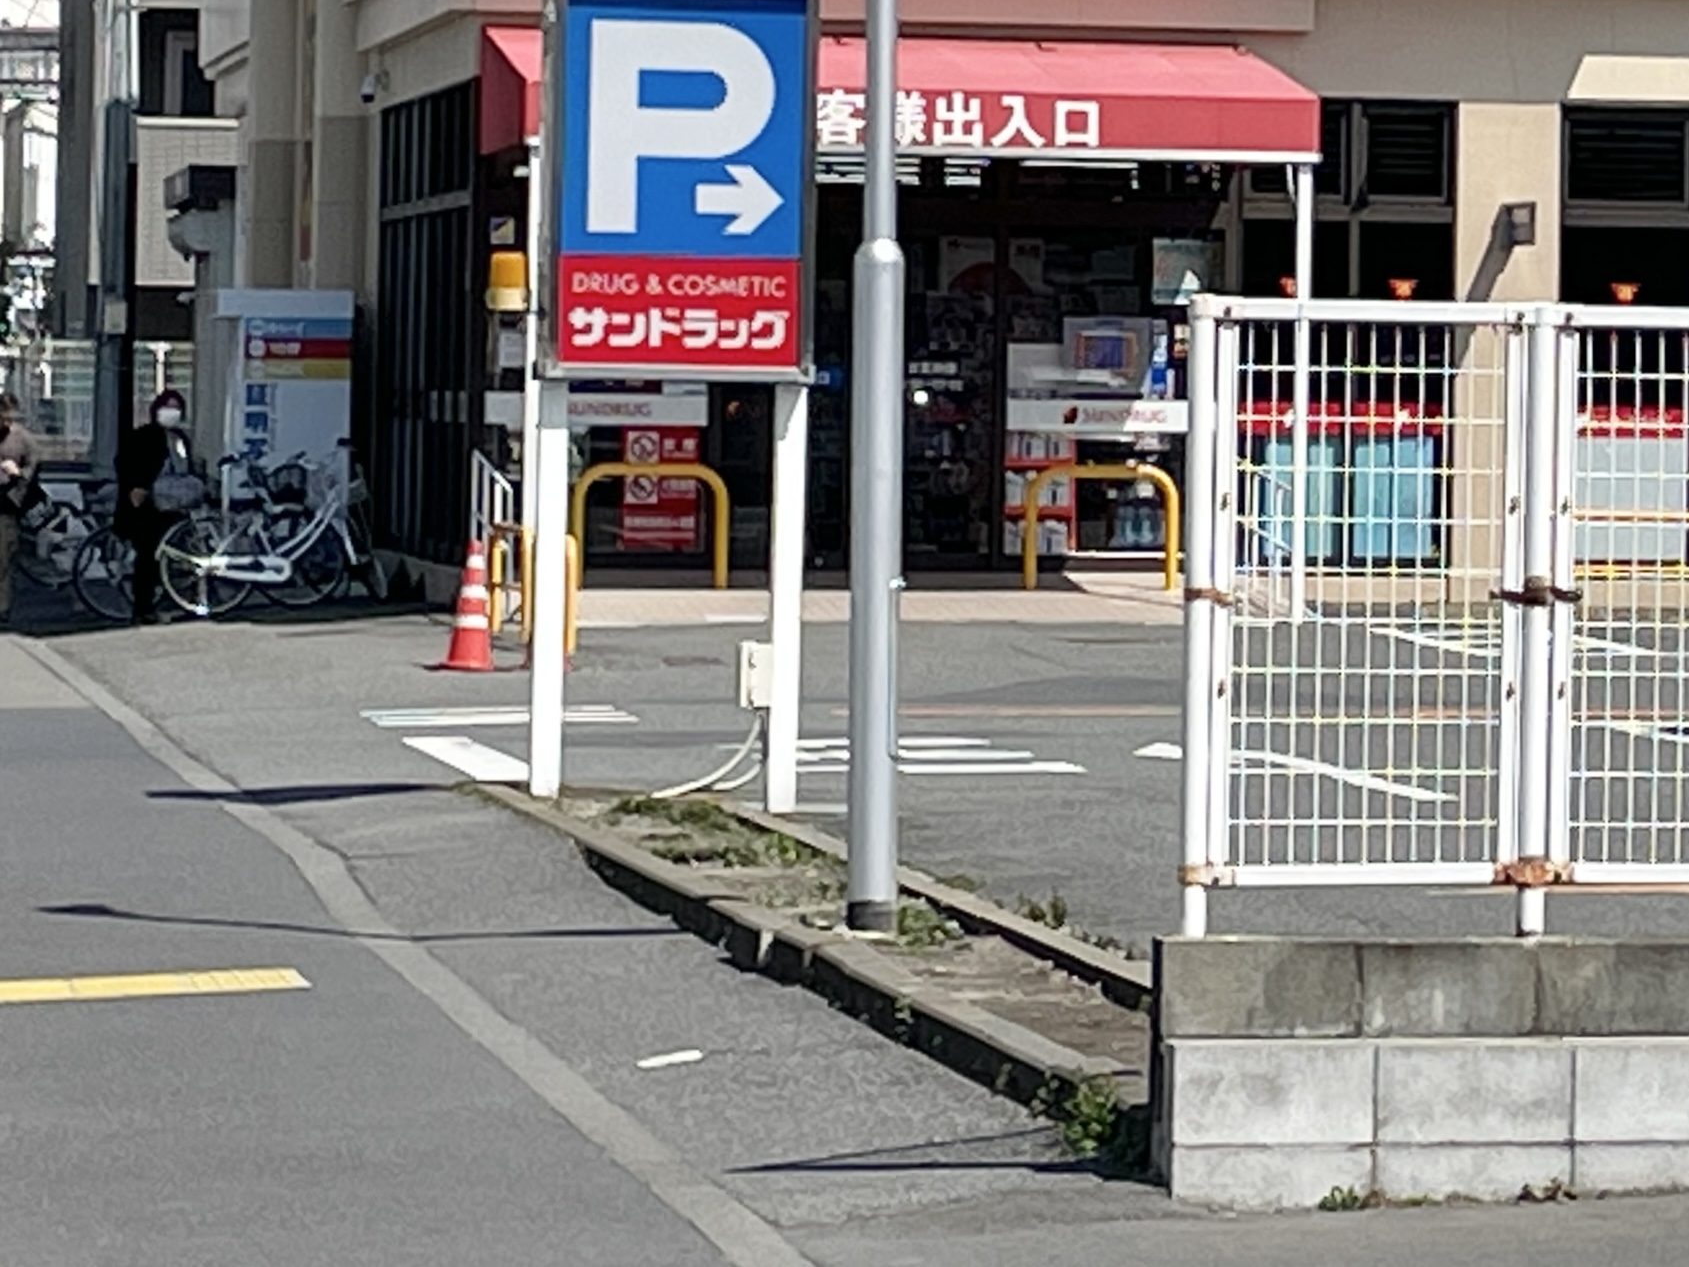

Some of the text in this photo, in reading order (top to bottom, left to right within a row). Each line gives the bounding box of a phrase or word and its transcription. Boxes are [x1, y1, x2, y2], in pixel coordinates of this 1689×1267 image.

[587, 18, 776, 233] P
[571, 271, 787, 298] DRUG & COSMETIC
[567, 306, 790, 350] サンドラッグ
